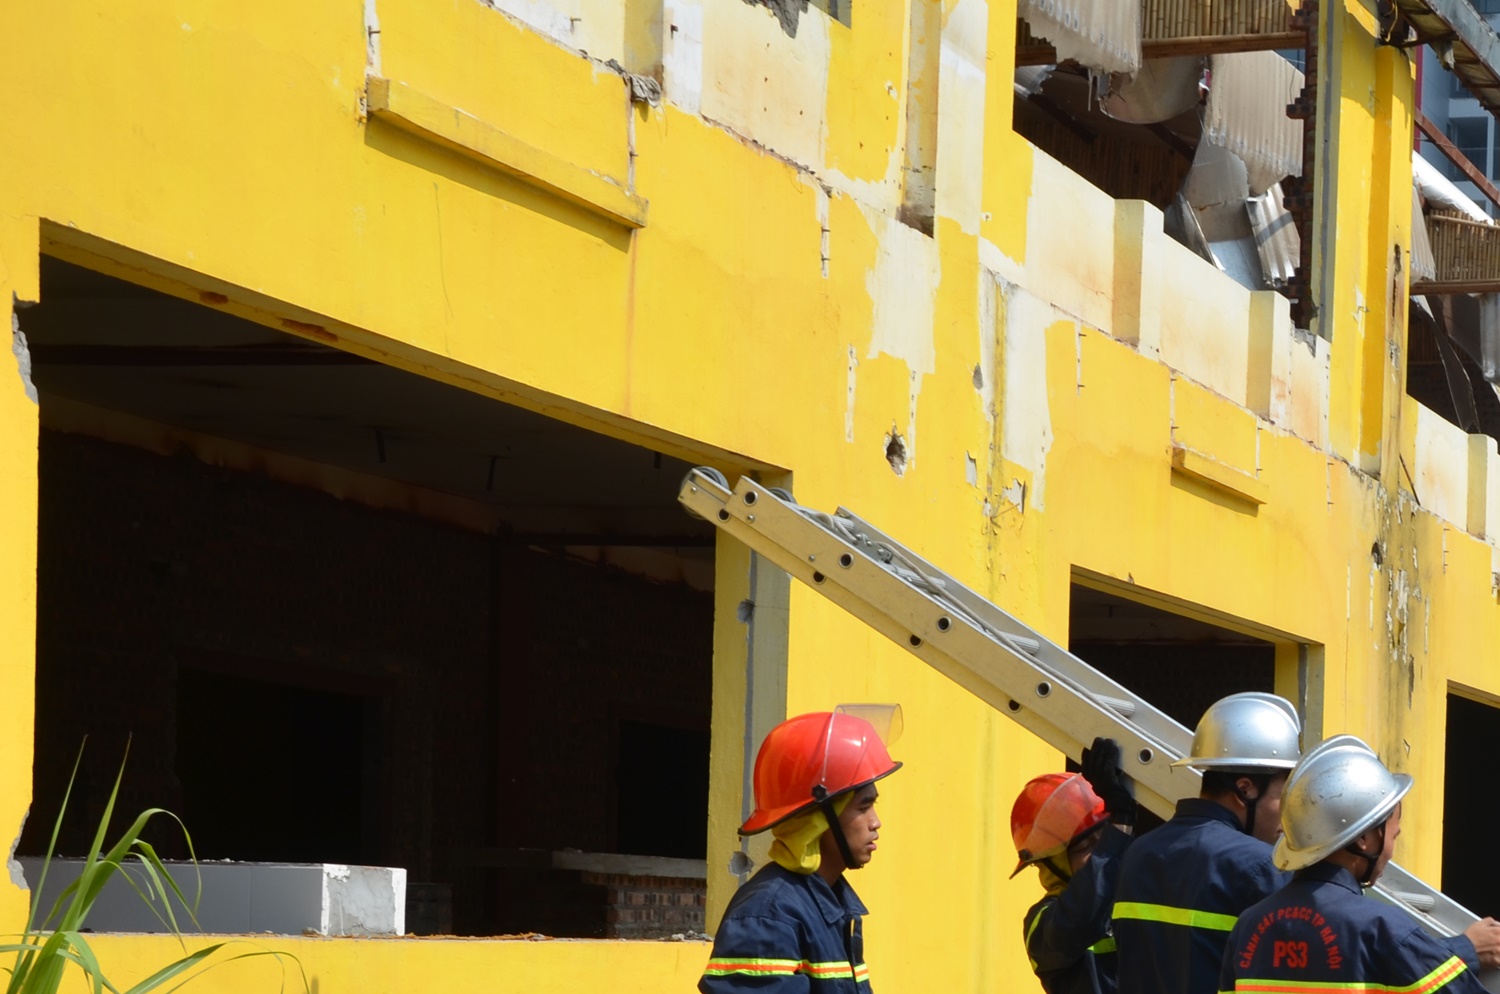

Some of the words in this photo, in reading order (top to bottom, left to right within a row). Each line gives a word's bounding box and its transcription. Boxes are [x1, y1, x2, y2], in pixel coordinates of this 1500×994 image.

[1273, 940, 1309, 968] PS3
[1277, 906, 1313, 921] PC&CC
[1311, 912, 1325, 928] TP
[1326, 945, 1343, 970] NỘI
